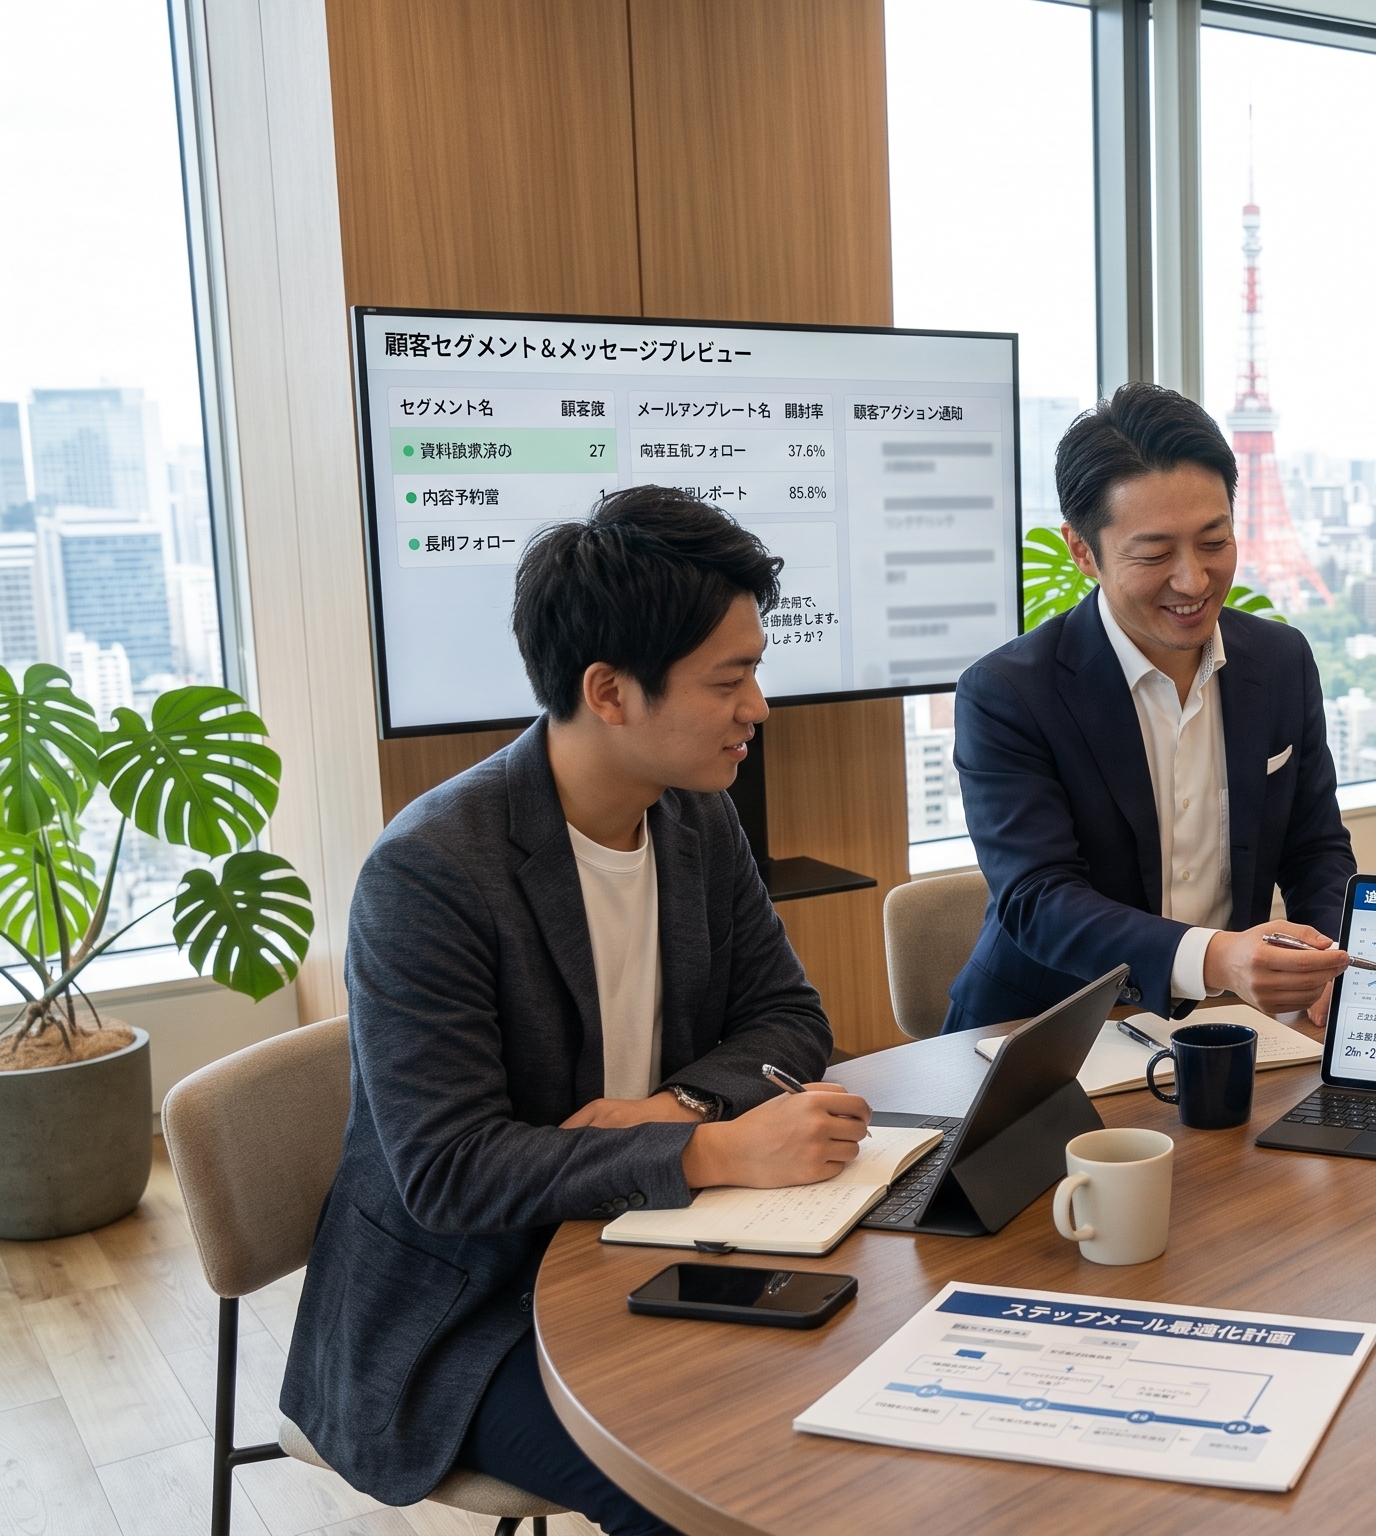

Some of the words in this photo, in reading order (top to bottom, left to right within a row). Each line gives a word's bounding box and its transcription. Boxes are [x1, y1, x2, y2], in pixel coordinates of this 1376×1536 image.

[399, 398, 494, 417] セグメント名
[589, 444, 606, 458] 27
[788, 444, 826, 457] 37.6%
[789, 486, 827, 499] 85.8%
[1001, 1303, 1297, 1346] ステップメール最適化計画
